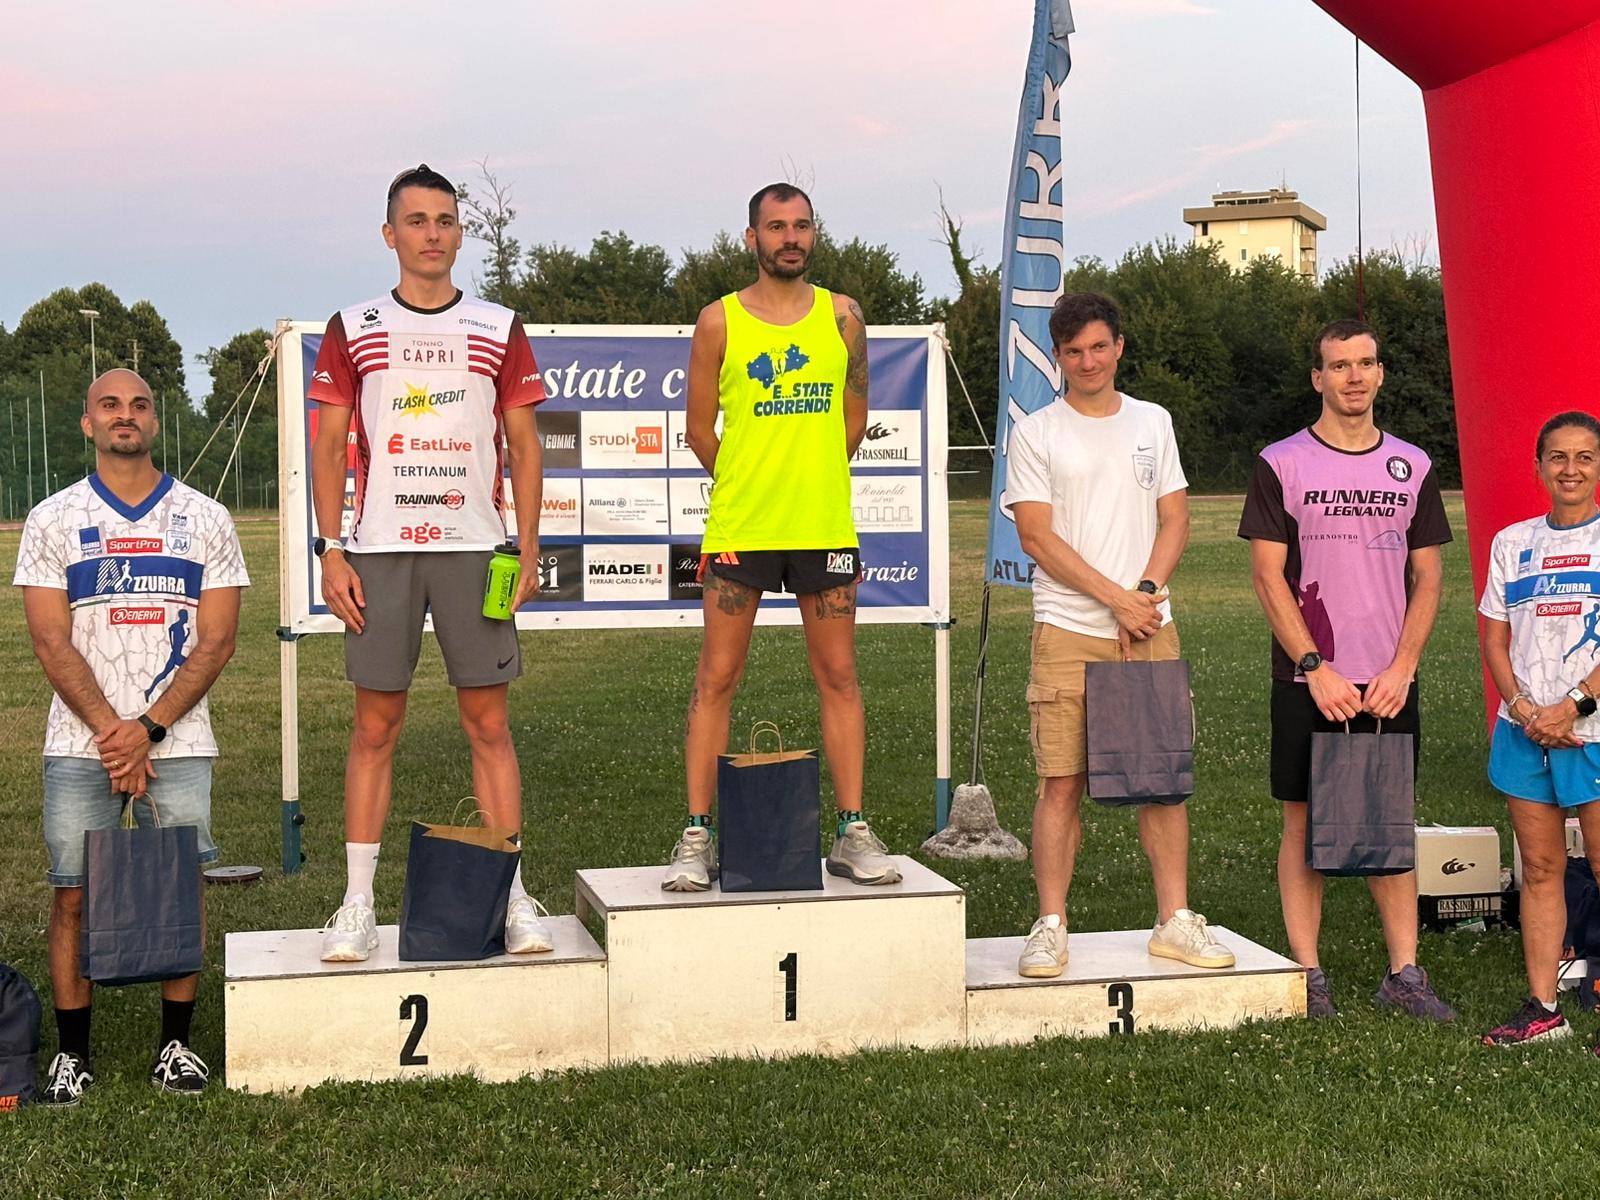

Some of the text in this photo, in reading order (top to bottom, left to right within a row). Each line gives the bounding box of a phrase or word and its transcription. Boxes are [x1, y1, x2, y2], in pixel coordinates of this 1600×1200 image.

[403, 348, 455, 363] CAPRI
[392, 389, 467, 411] FLASH CREDIT
[753, 398, 831, 417] CORRENDO
[410, 438, 472, 452] EatLive
[545, 434, 577, 449] GOMME
[857, 447, 908, 460] FRASSINELLI
[393, 466, 467, 477] TERTIANUM
[394, 494, 465, 505] TRAINING991
[1303, 490, 1409, 507] RUNNERS
[1323, 506, 1396, 517] LEGNANO
[400, 522, 441, 544] age
[109, 539, 160, 552] SportPro
[1544, 556, 1588, 567] SportPro
[589, 564, 646, 575] MADE
[645, 577, 662, 586] Figlio
[127, 610, 163, 621] ENERVIT
[779, 953, 797, 1021] 1
[1108, 983, 1134, 1034] 3
[400, 995, 428, 1066] 2
